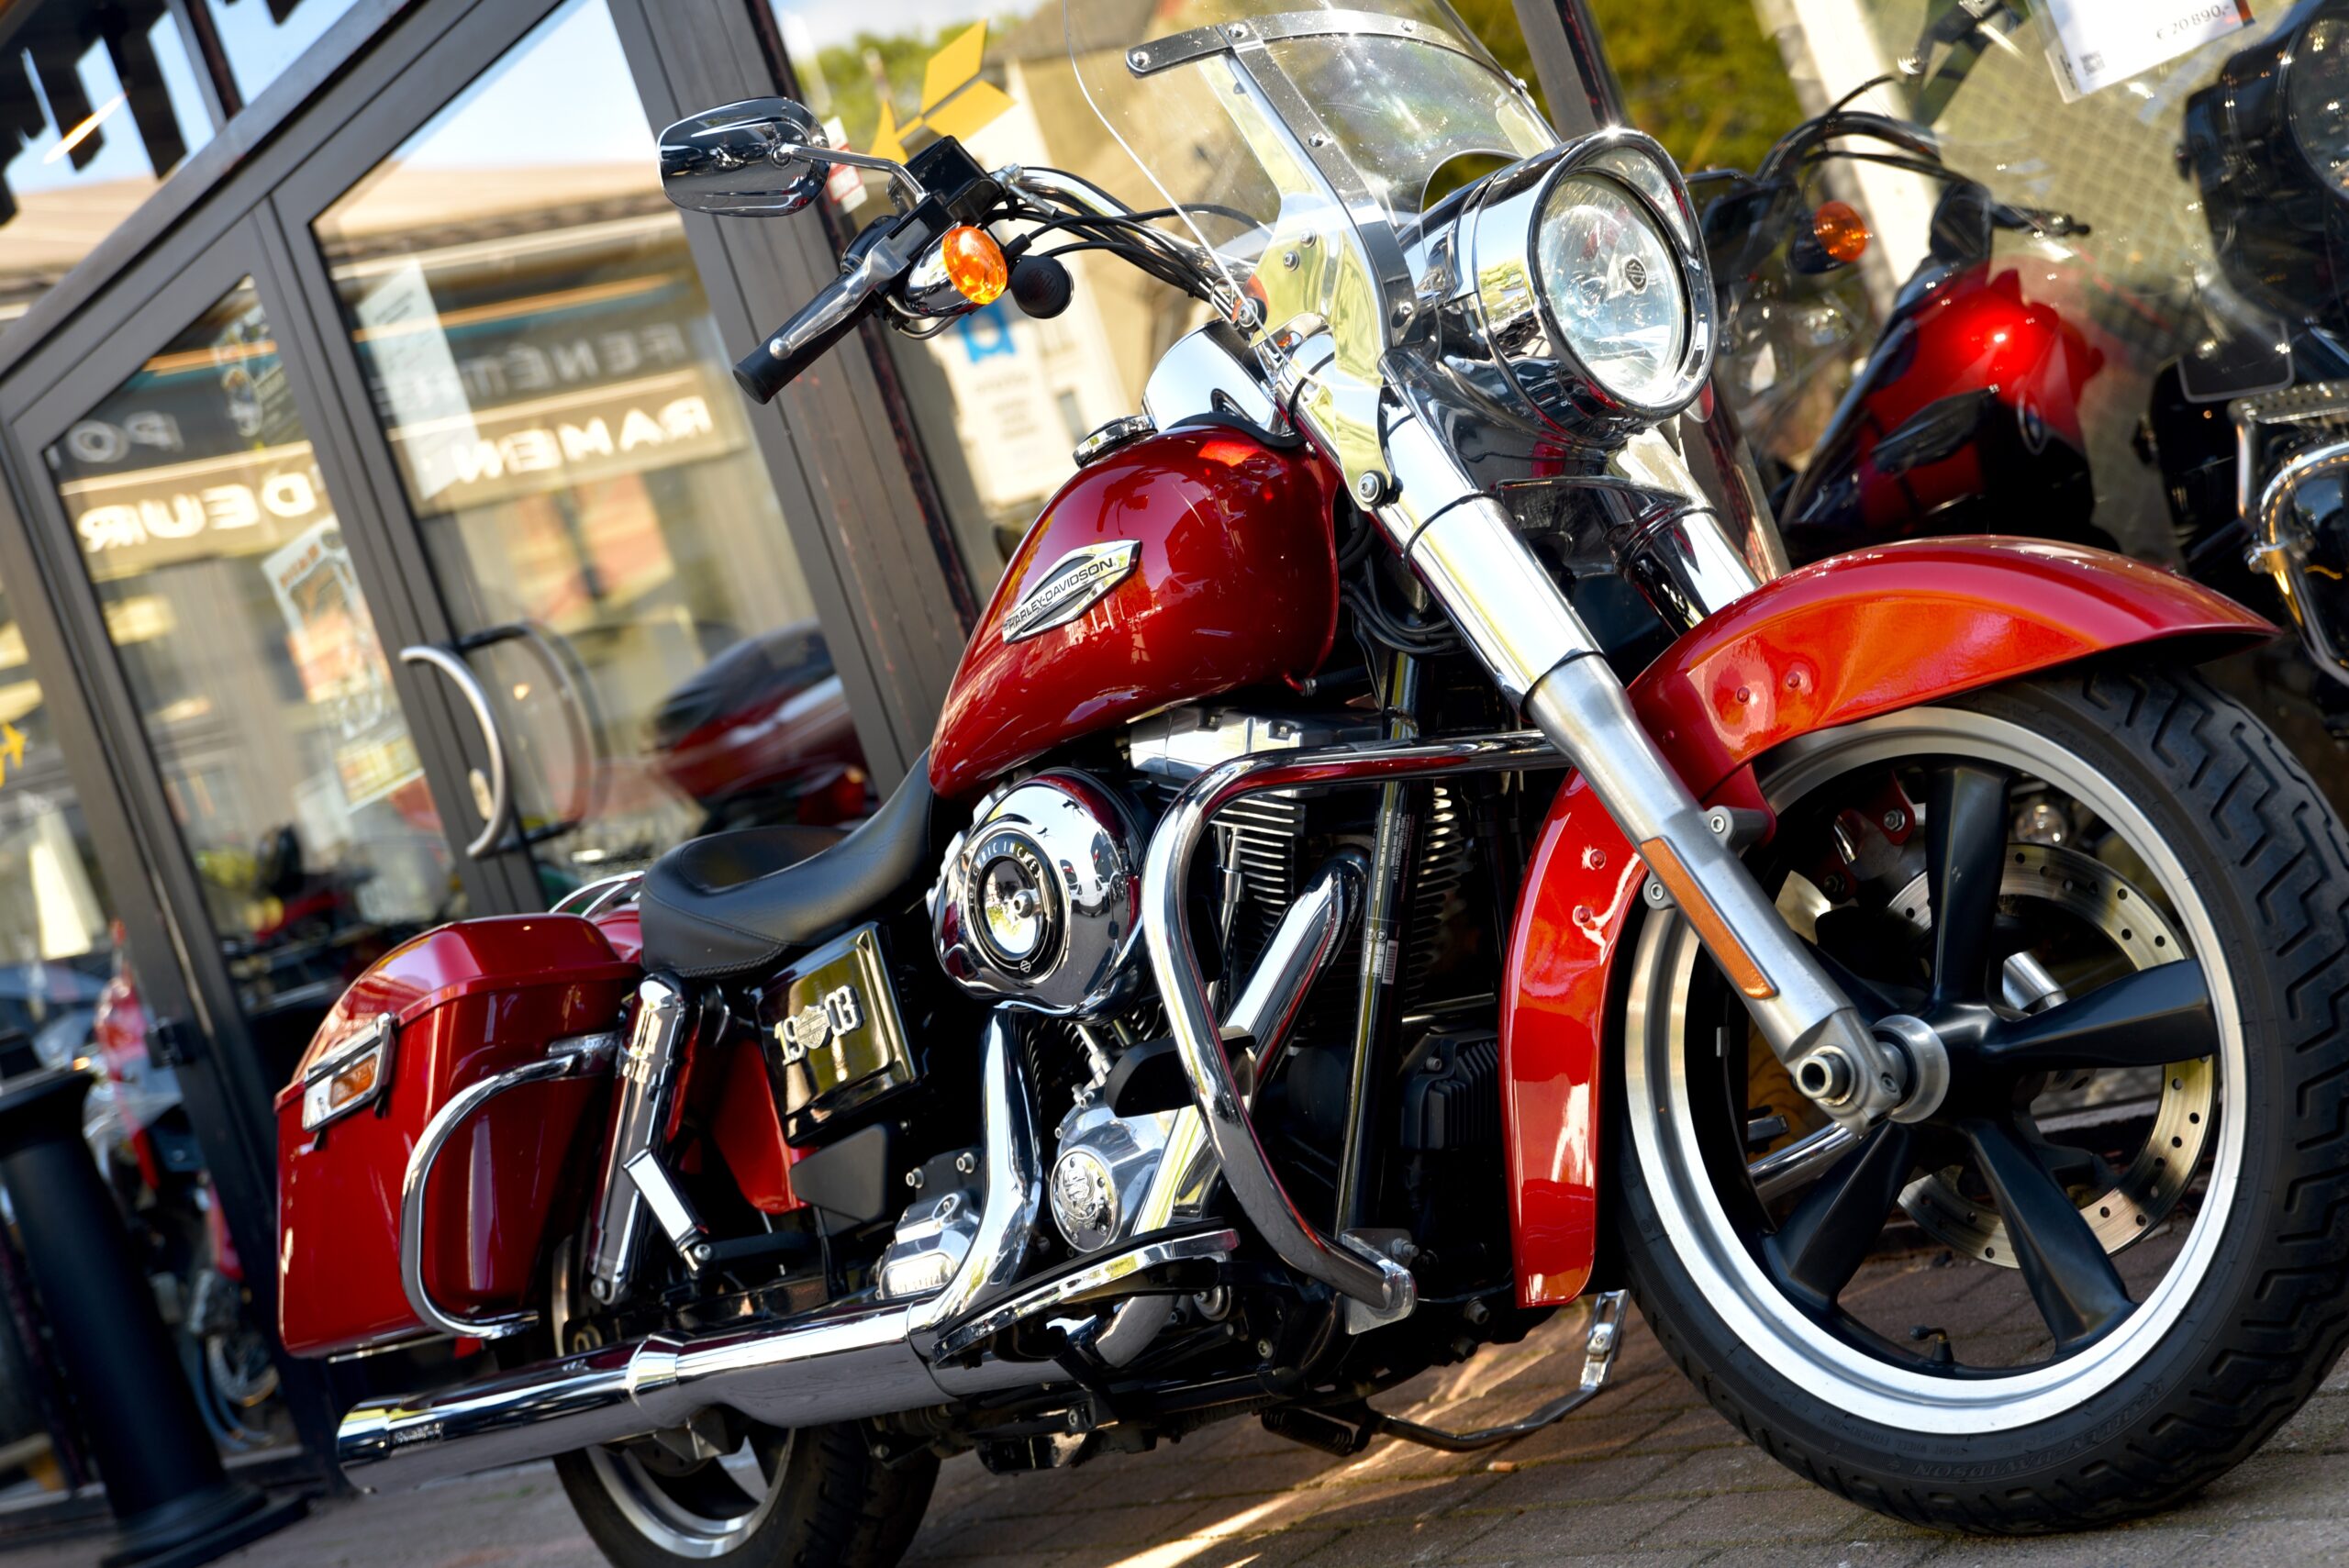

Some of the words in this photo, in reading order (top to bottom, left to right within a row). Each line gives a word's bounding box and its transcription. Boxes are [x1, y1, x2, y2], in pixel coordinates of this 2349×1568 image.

[1008, 557, 1114, 633] HARLEY-DAVIDSON
[973, 841, 998, 877] CUBIC
[1003, 840, 1041, 880] INCHES
